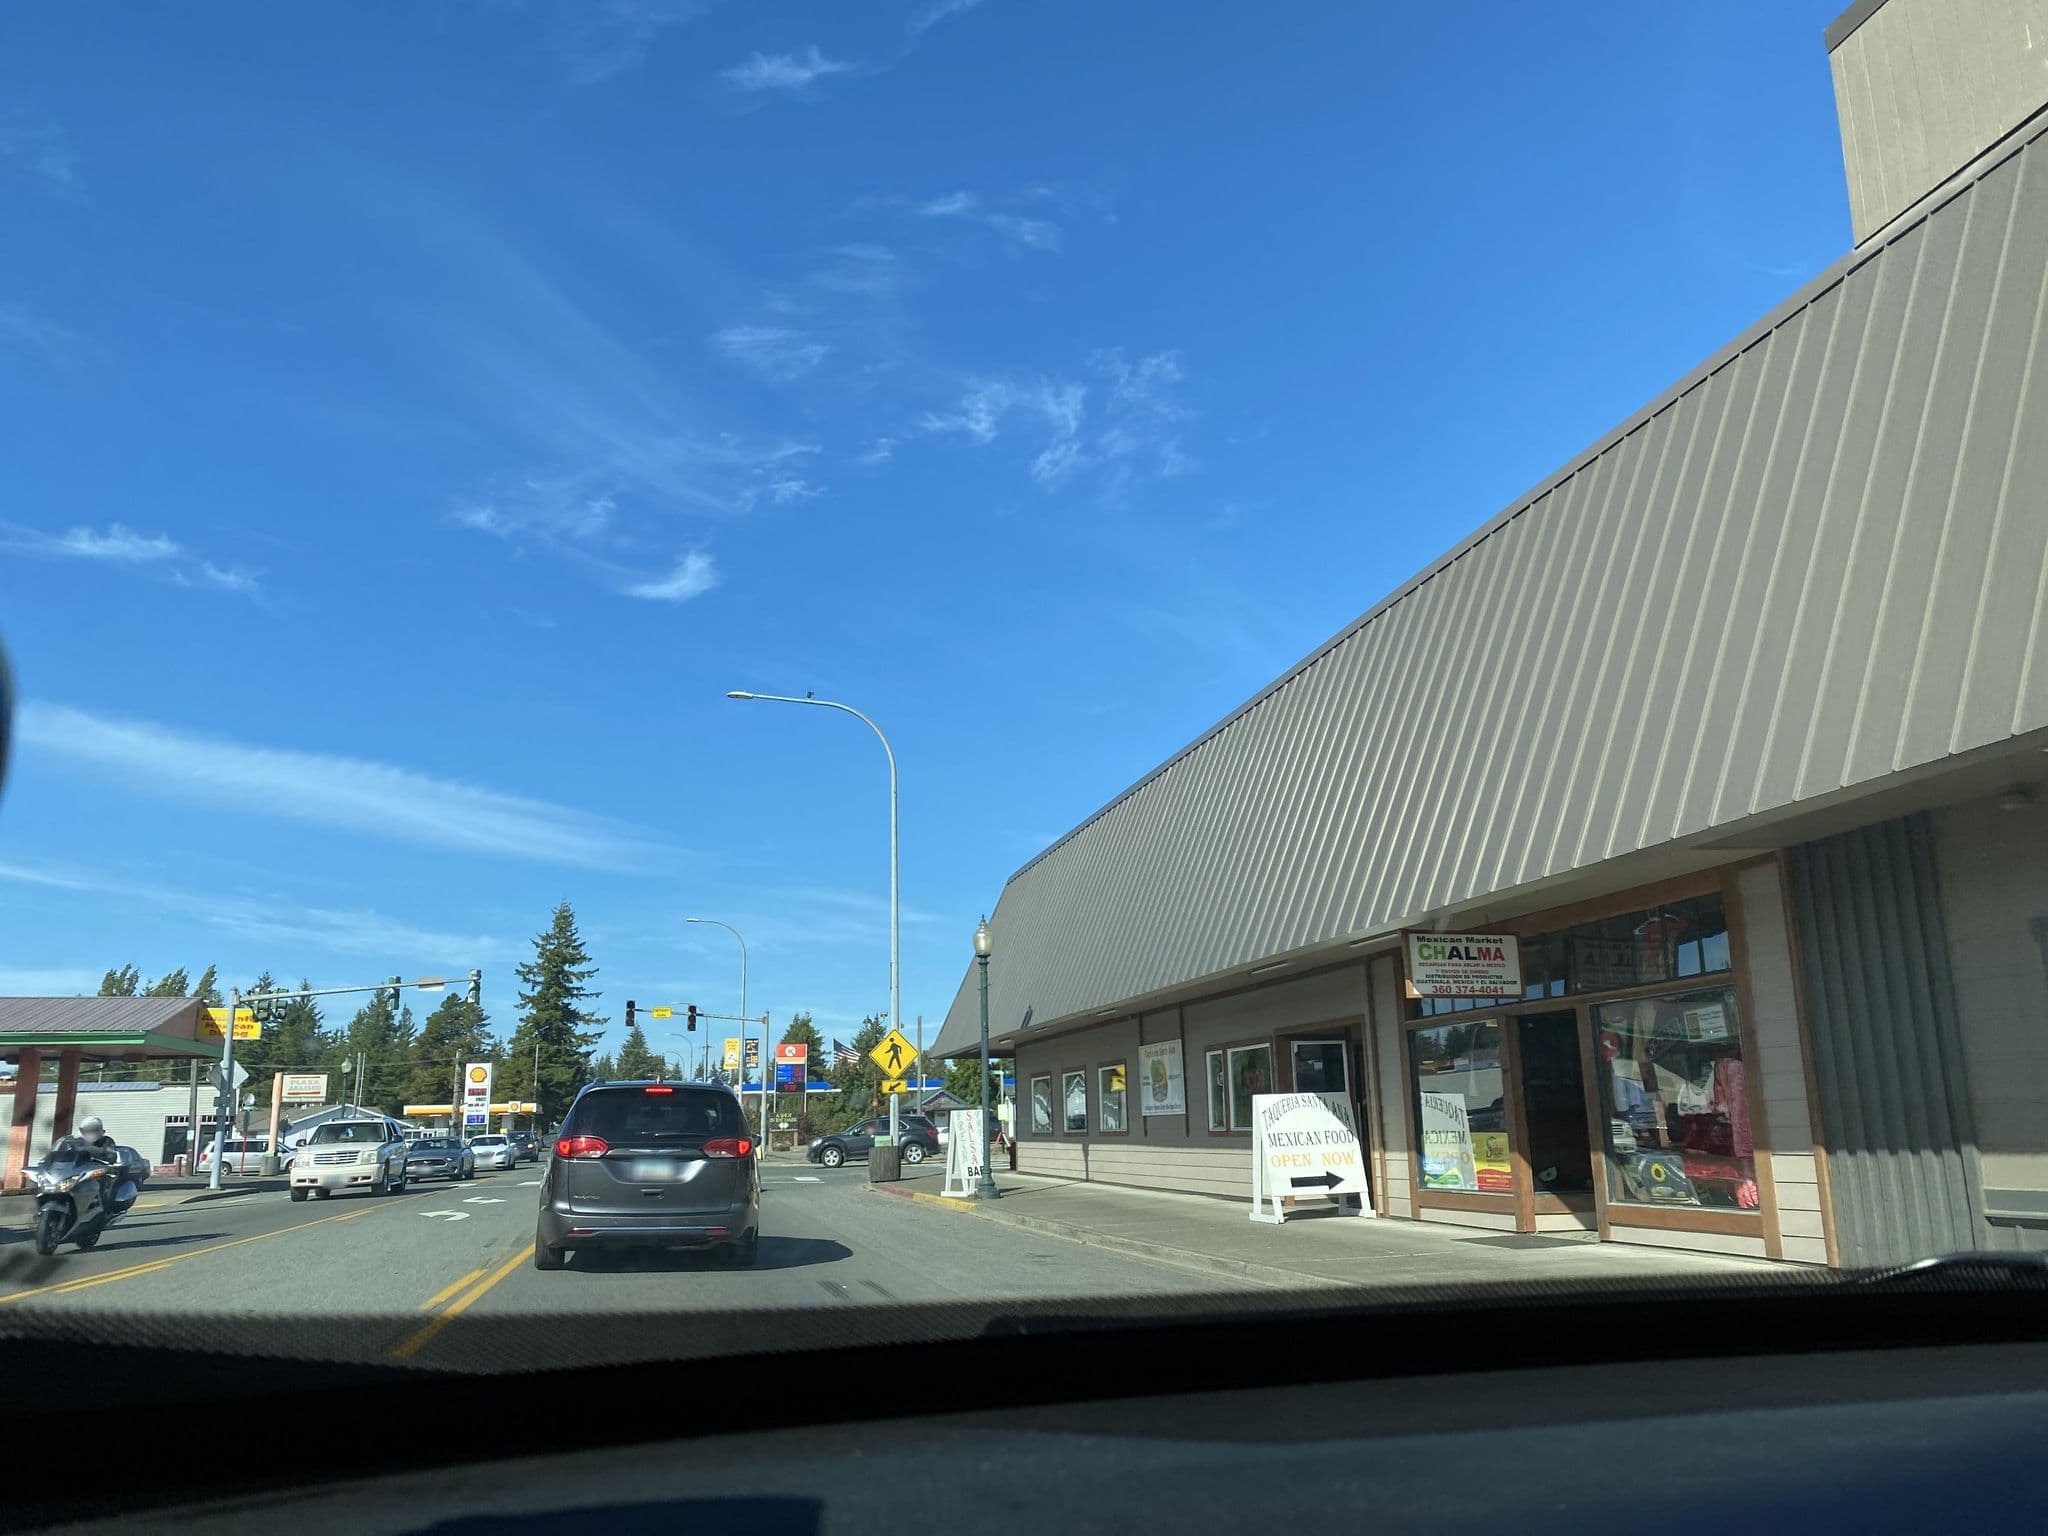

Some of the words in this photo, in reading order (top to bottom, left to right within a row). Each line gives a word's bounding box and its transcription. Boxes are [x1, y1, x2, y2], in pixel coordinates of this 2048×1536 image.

[1416, 935, 1462, 943] Mexican
[1466, 936, 1503, 944] Market
[1418, 943, 1505, 961] CHALMA
[1432, 985, 1452, 994] 360
[1455, 986, 1504, 994] 374-4041
[205, 1022, 254, 1030] Mexcan
[1261, 1095, 1299, 1131] TAQUERIA
[1301, 1094, 1330, 1113] SANTA
[1331, 1100, 1353, 1130] ANA
[966, 1111, 978, 1164] SALSA
[1268, 1130, 1322, 1148] MEXICAN
[1324, 1129, 1355, 1145] FOOD
[1271, 1152, 1313, 1169] OPEN
[1321, 1150, 1356, 1167] NOW
